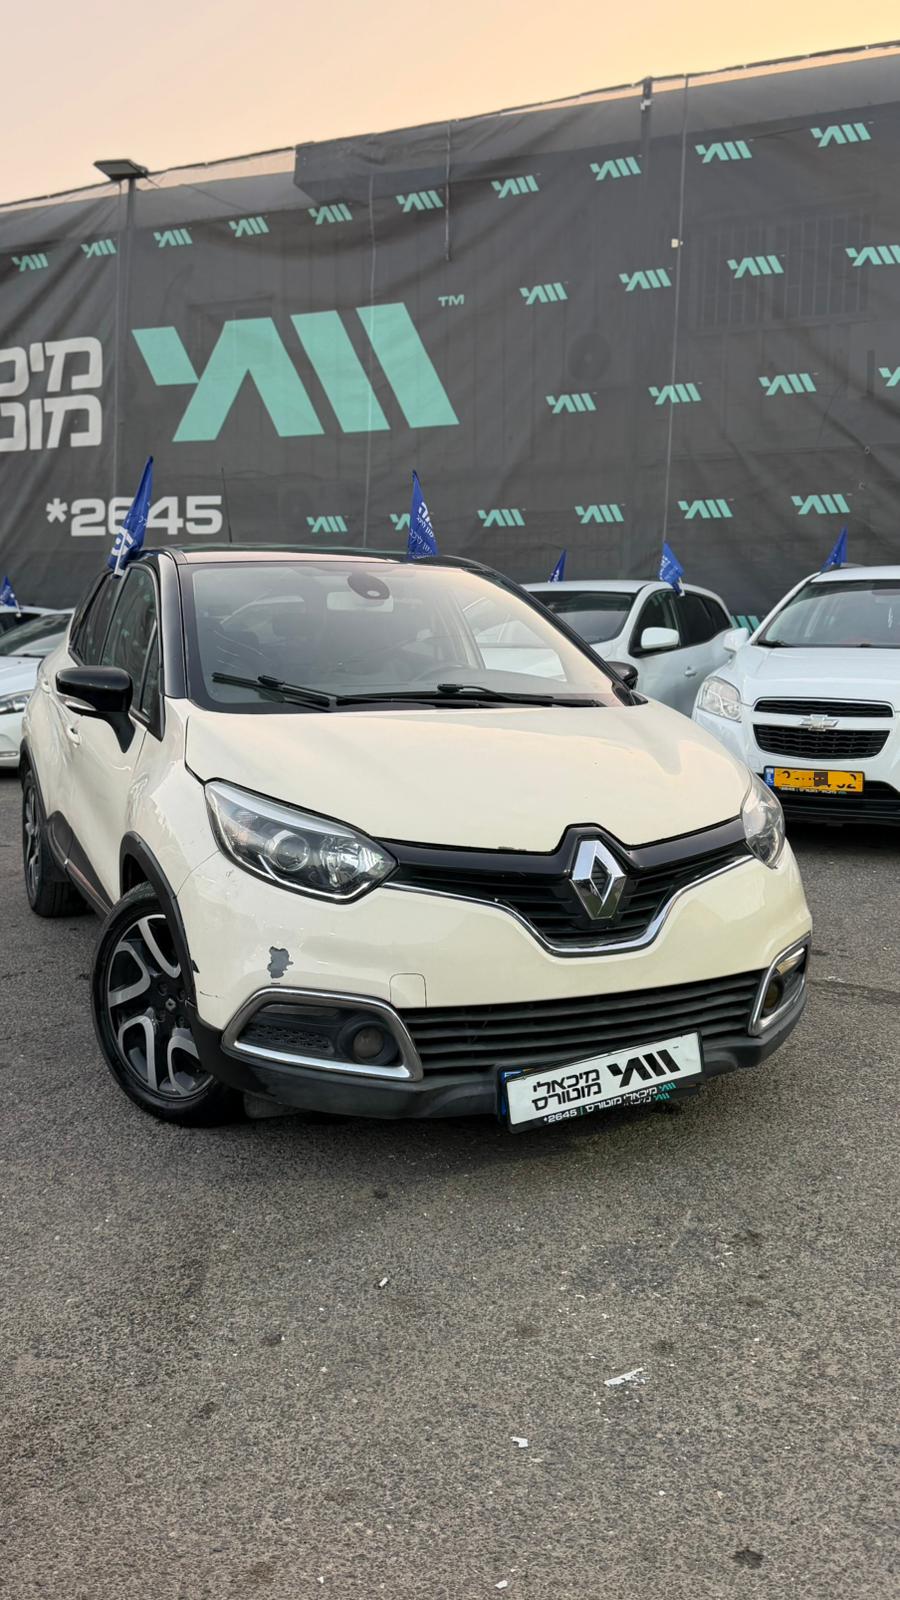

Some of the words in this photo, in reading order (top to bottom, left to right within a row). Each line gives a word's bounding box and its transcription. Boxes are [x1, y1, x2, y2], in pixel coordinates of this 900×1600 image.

[438, 294, 465, 307] TM
[532, 1069, 600, 1095] מיכאלי
[531, 1082, 602, 1111] מוטורס
[623, 1086, 658, 1101] מיכאלי
[585, 1097, 623, 1113] מוטורס
